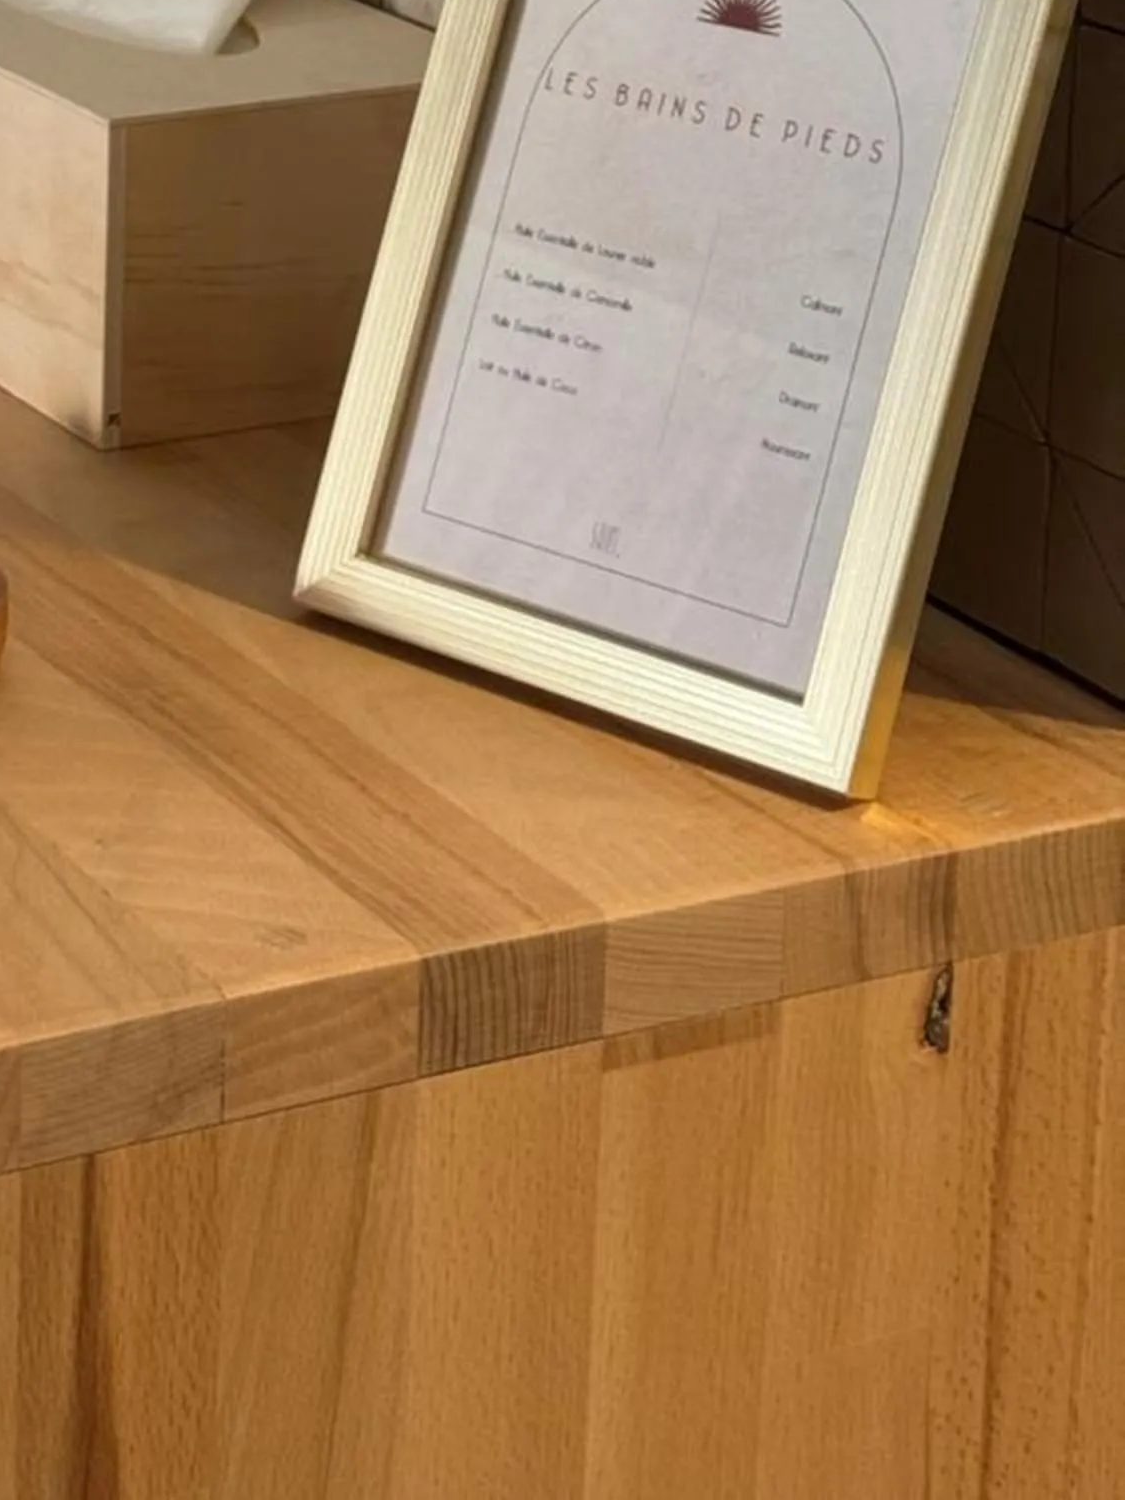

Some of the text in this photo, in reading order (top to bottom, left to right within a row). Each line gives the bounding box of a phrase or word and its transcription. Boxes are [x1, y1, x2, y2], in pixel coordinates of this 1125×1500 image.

[543, 67, 886, 165] LES BAINS DE PIEDS
